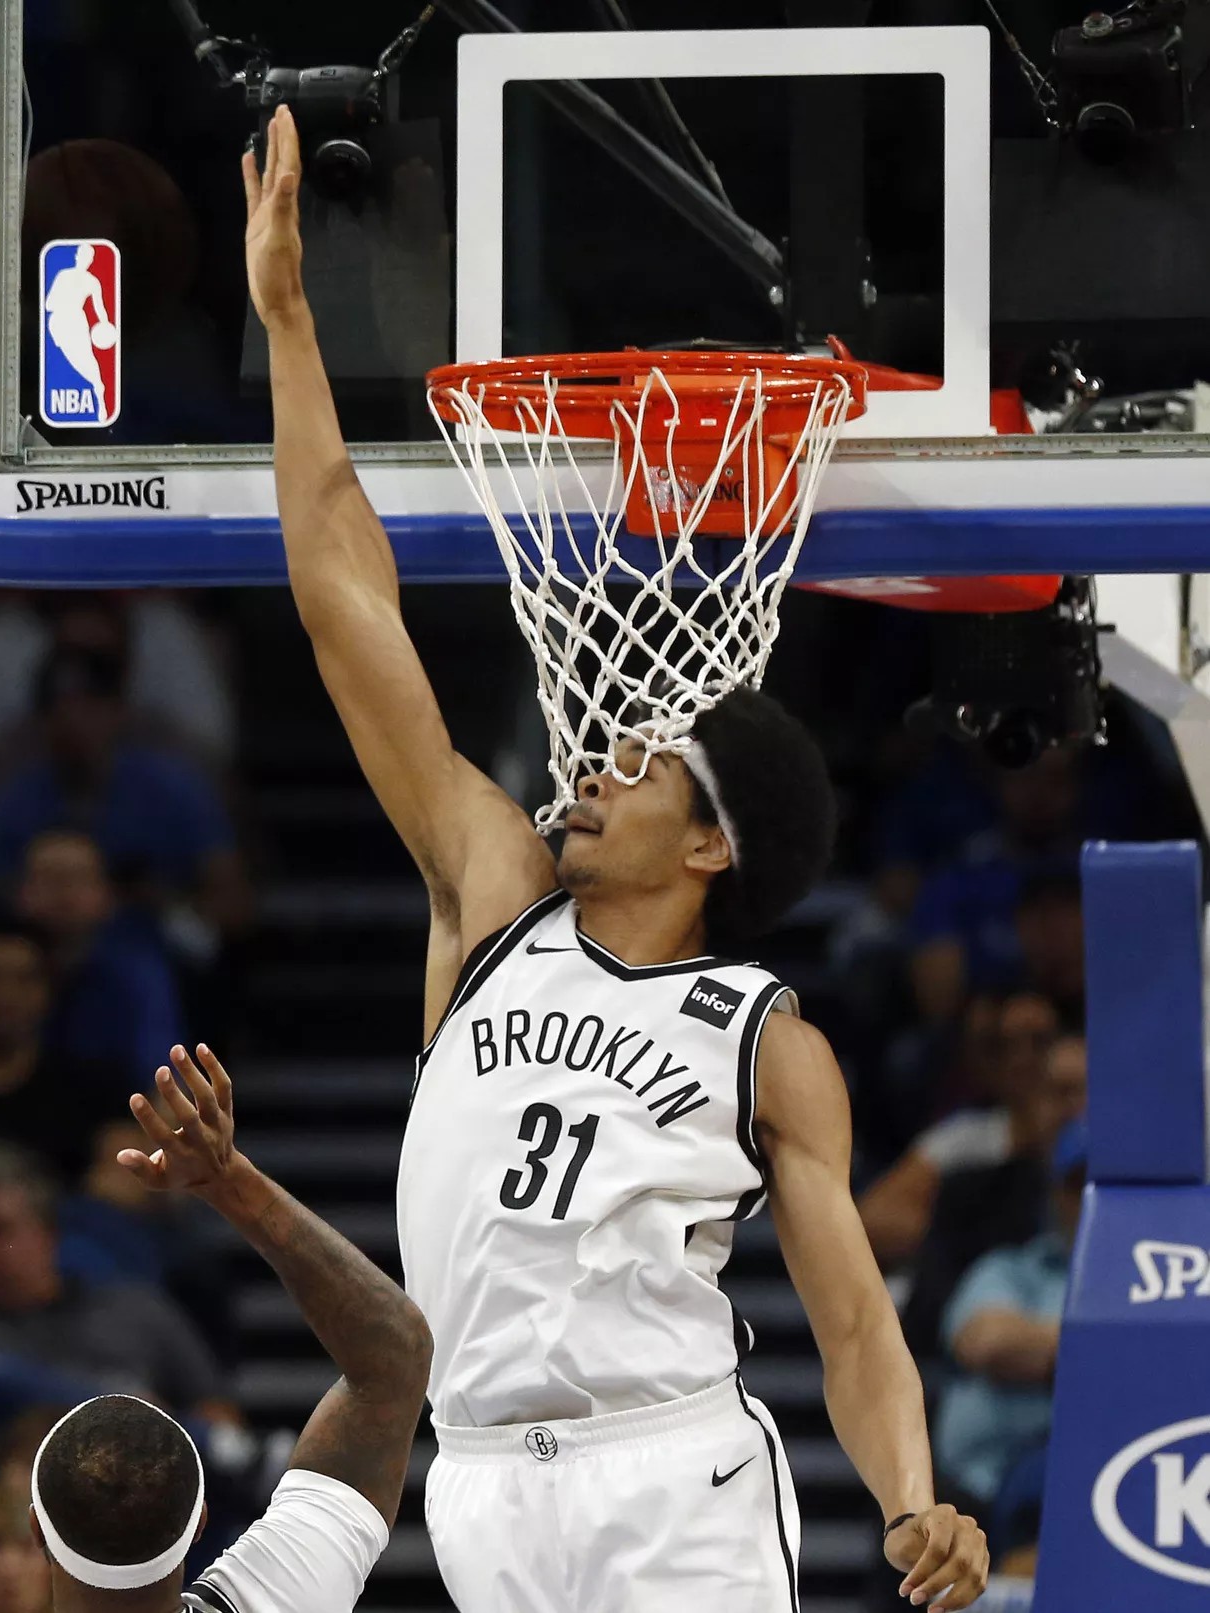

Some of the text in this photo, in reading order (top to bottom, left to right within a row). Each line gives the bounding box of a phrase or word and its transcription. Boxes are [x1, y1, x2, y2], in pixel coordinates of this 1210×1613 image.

[50, 388, 95, 415] NBA
[16, 475, 167, 514] SPALDING
[690, 985, 736, 1016] infor
[471, 1008, 711, 1129] BROOKLYN
[498, 1101, 600, 1221] 31
[534, 1432, 549, 1456] B
